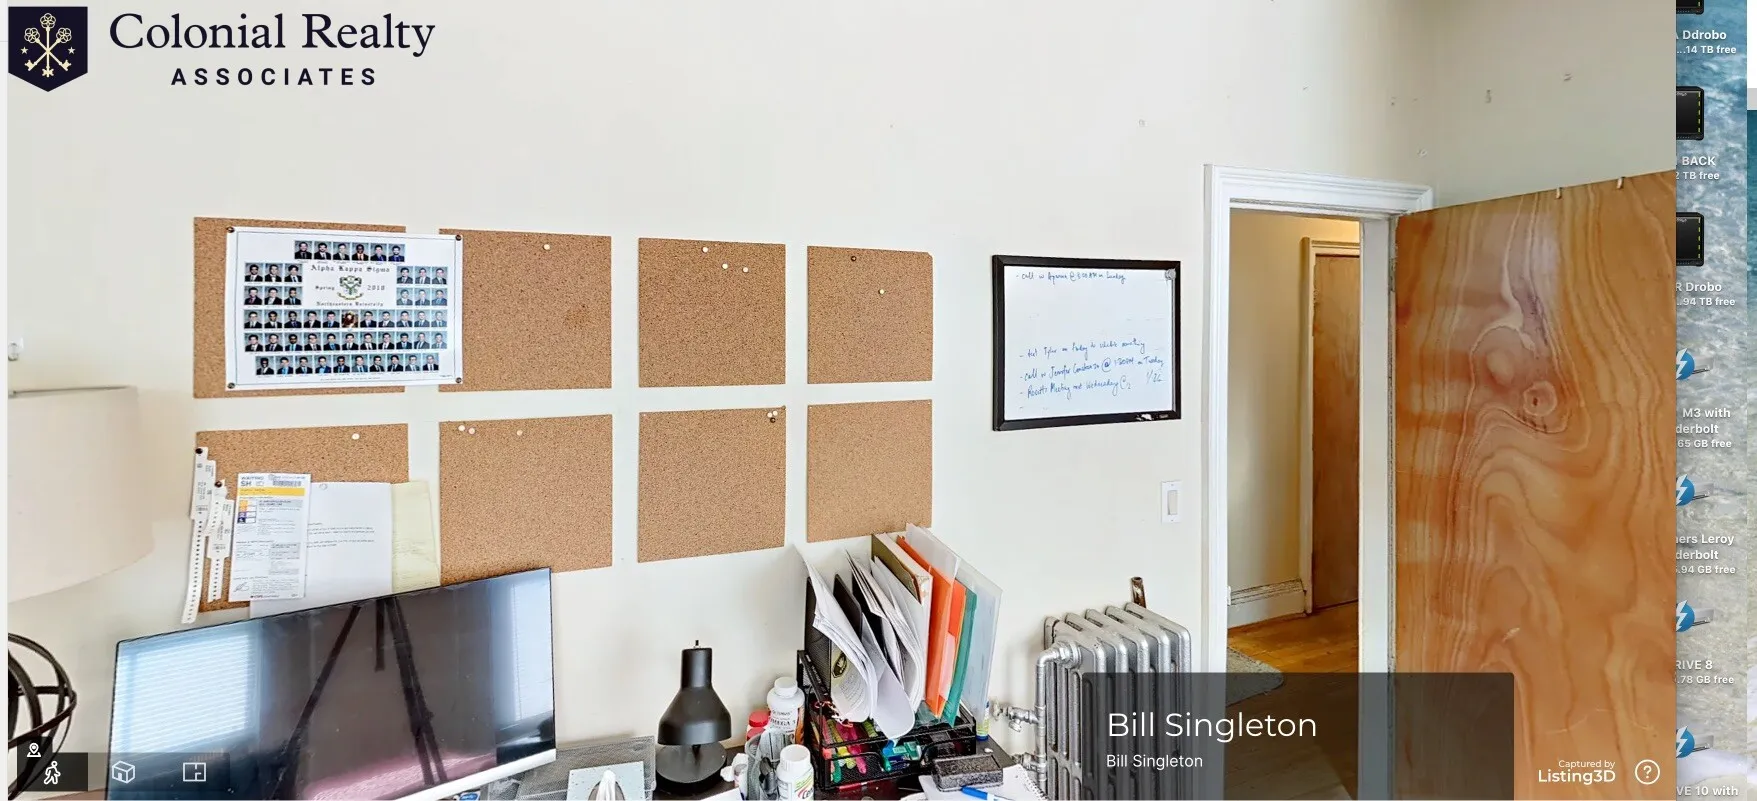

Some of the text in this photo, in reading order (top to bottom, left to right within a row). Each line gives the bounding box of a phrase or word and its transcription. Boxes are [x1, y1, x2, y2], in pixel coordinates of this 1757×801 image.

[1682, 29, 1727, 40] Ddrobo
[1700, 45, 1714, 54] TB
[1716, 45, 1737, 54] free
[1682, 155, 1716, 166] BACK
[1682, 171, 1697, 180] TB
[1699, 171, 1720, 180] free
[311, 264, 390, 274] Alpha Kappa Sigma
[1685, 281, 1722, 292] Drobo
[1699, 297, 1713, 306] TB
[1715, 297, 1736, 306] free
[1682, 407, 1731, 418] M3 with
[1693, 439, 1708, 448] GB
[1711, 439, 1732, 448] free
[1701, 533, 1735, 546] Leroy
[1697, 565, 1712, 574] GB
[1714, 565, 1736, 574] free
[1705, 659, 1713, 670] 8
[1696, 675, 1711, 684] GB
[1713, 675, 1735, 684] free
[1695, 785, 1709, 796] 10
[1712, 785, 1739, 796] with
